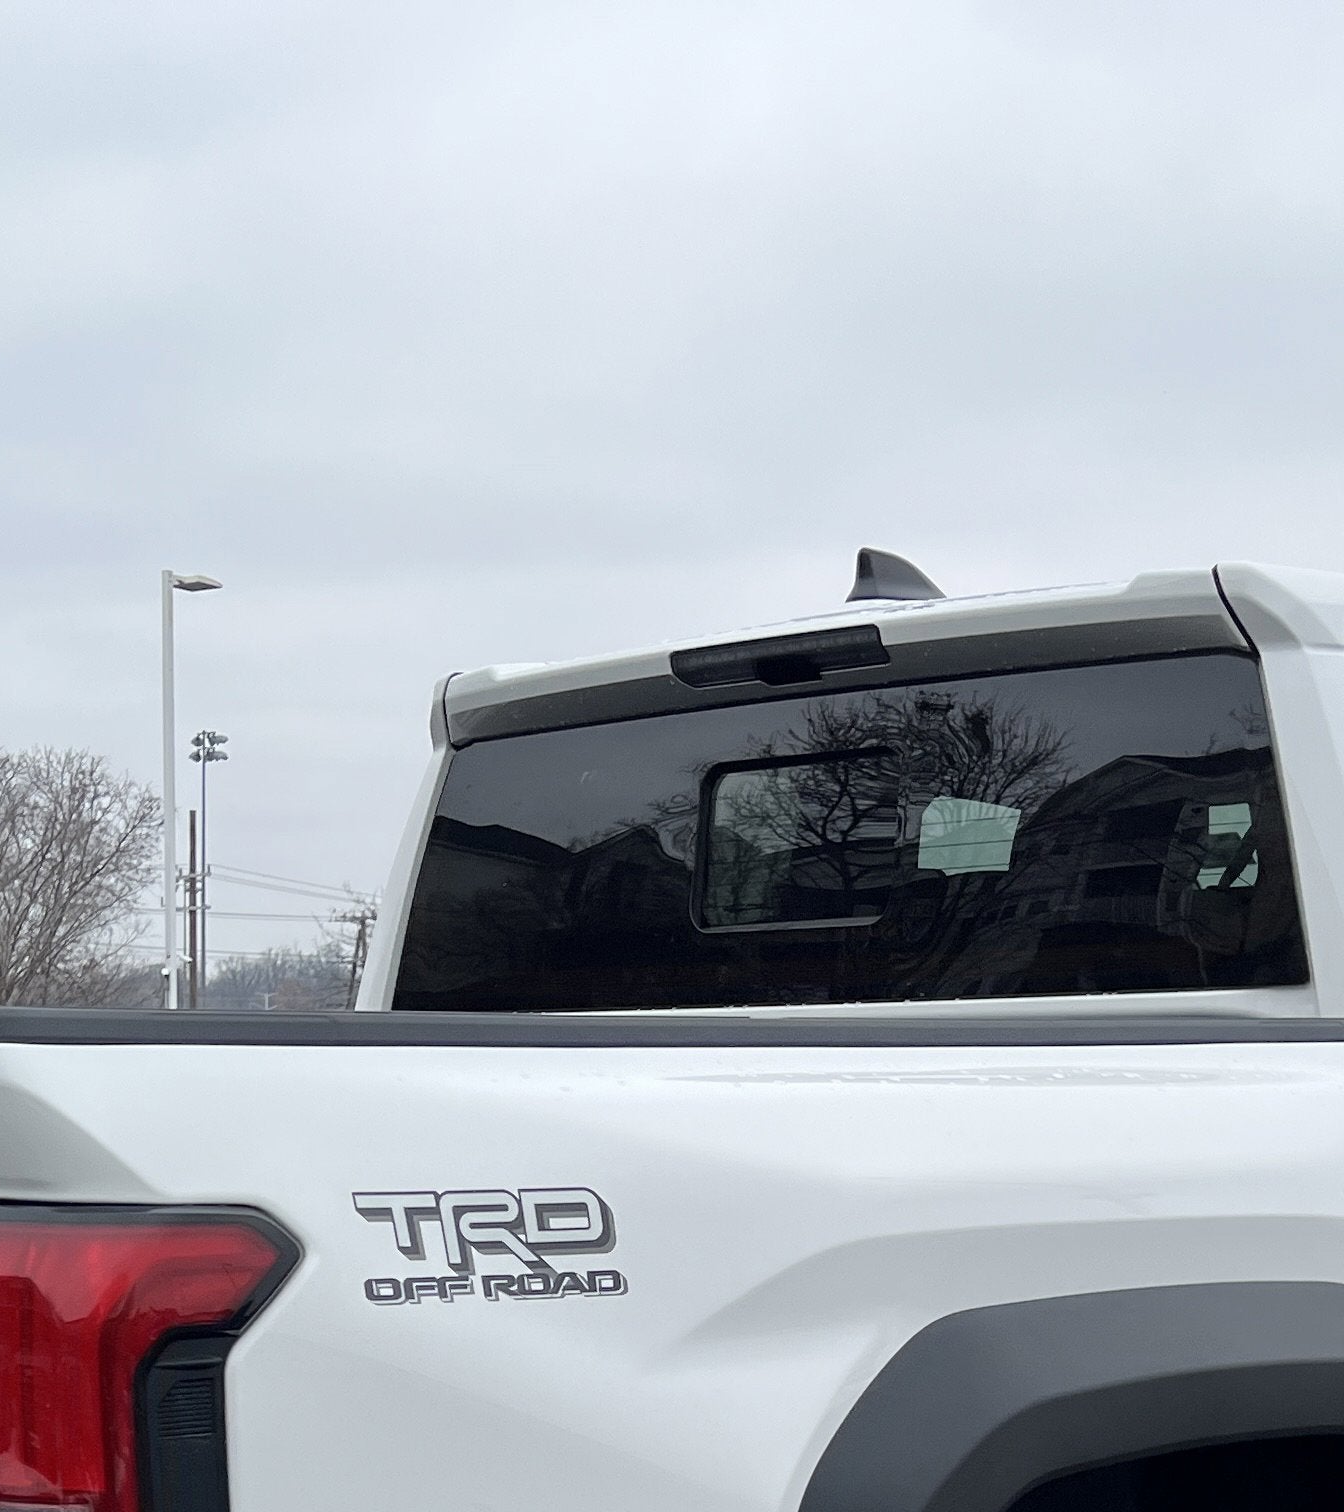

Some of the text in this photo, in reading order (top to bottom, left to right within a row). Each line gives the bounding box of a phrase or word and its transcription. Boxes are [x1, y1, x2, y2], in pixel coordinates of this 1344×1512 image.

[352, 1187, 617, 1275] TRD
[364, 1269, 629, 1305] OFF ROAD
